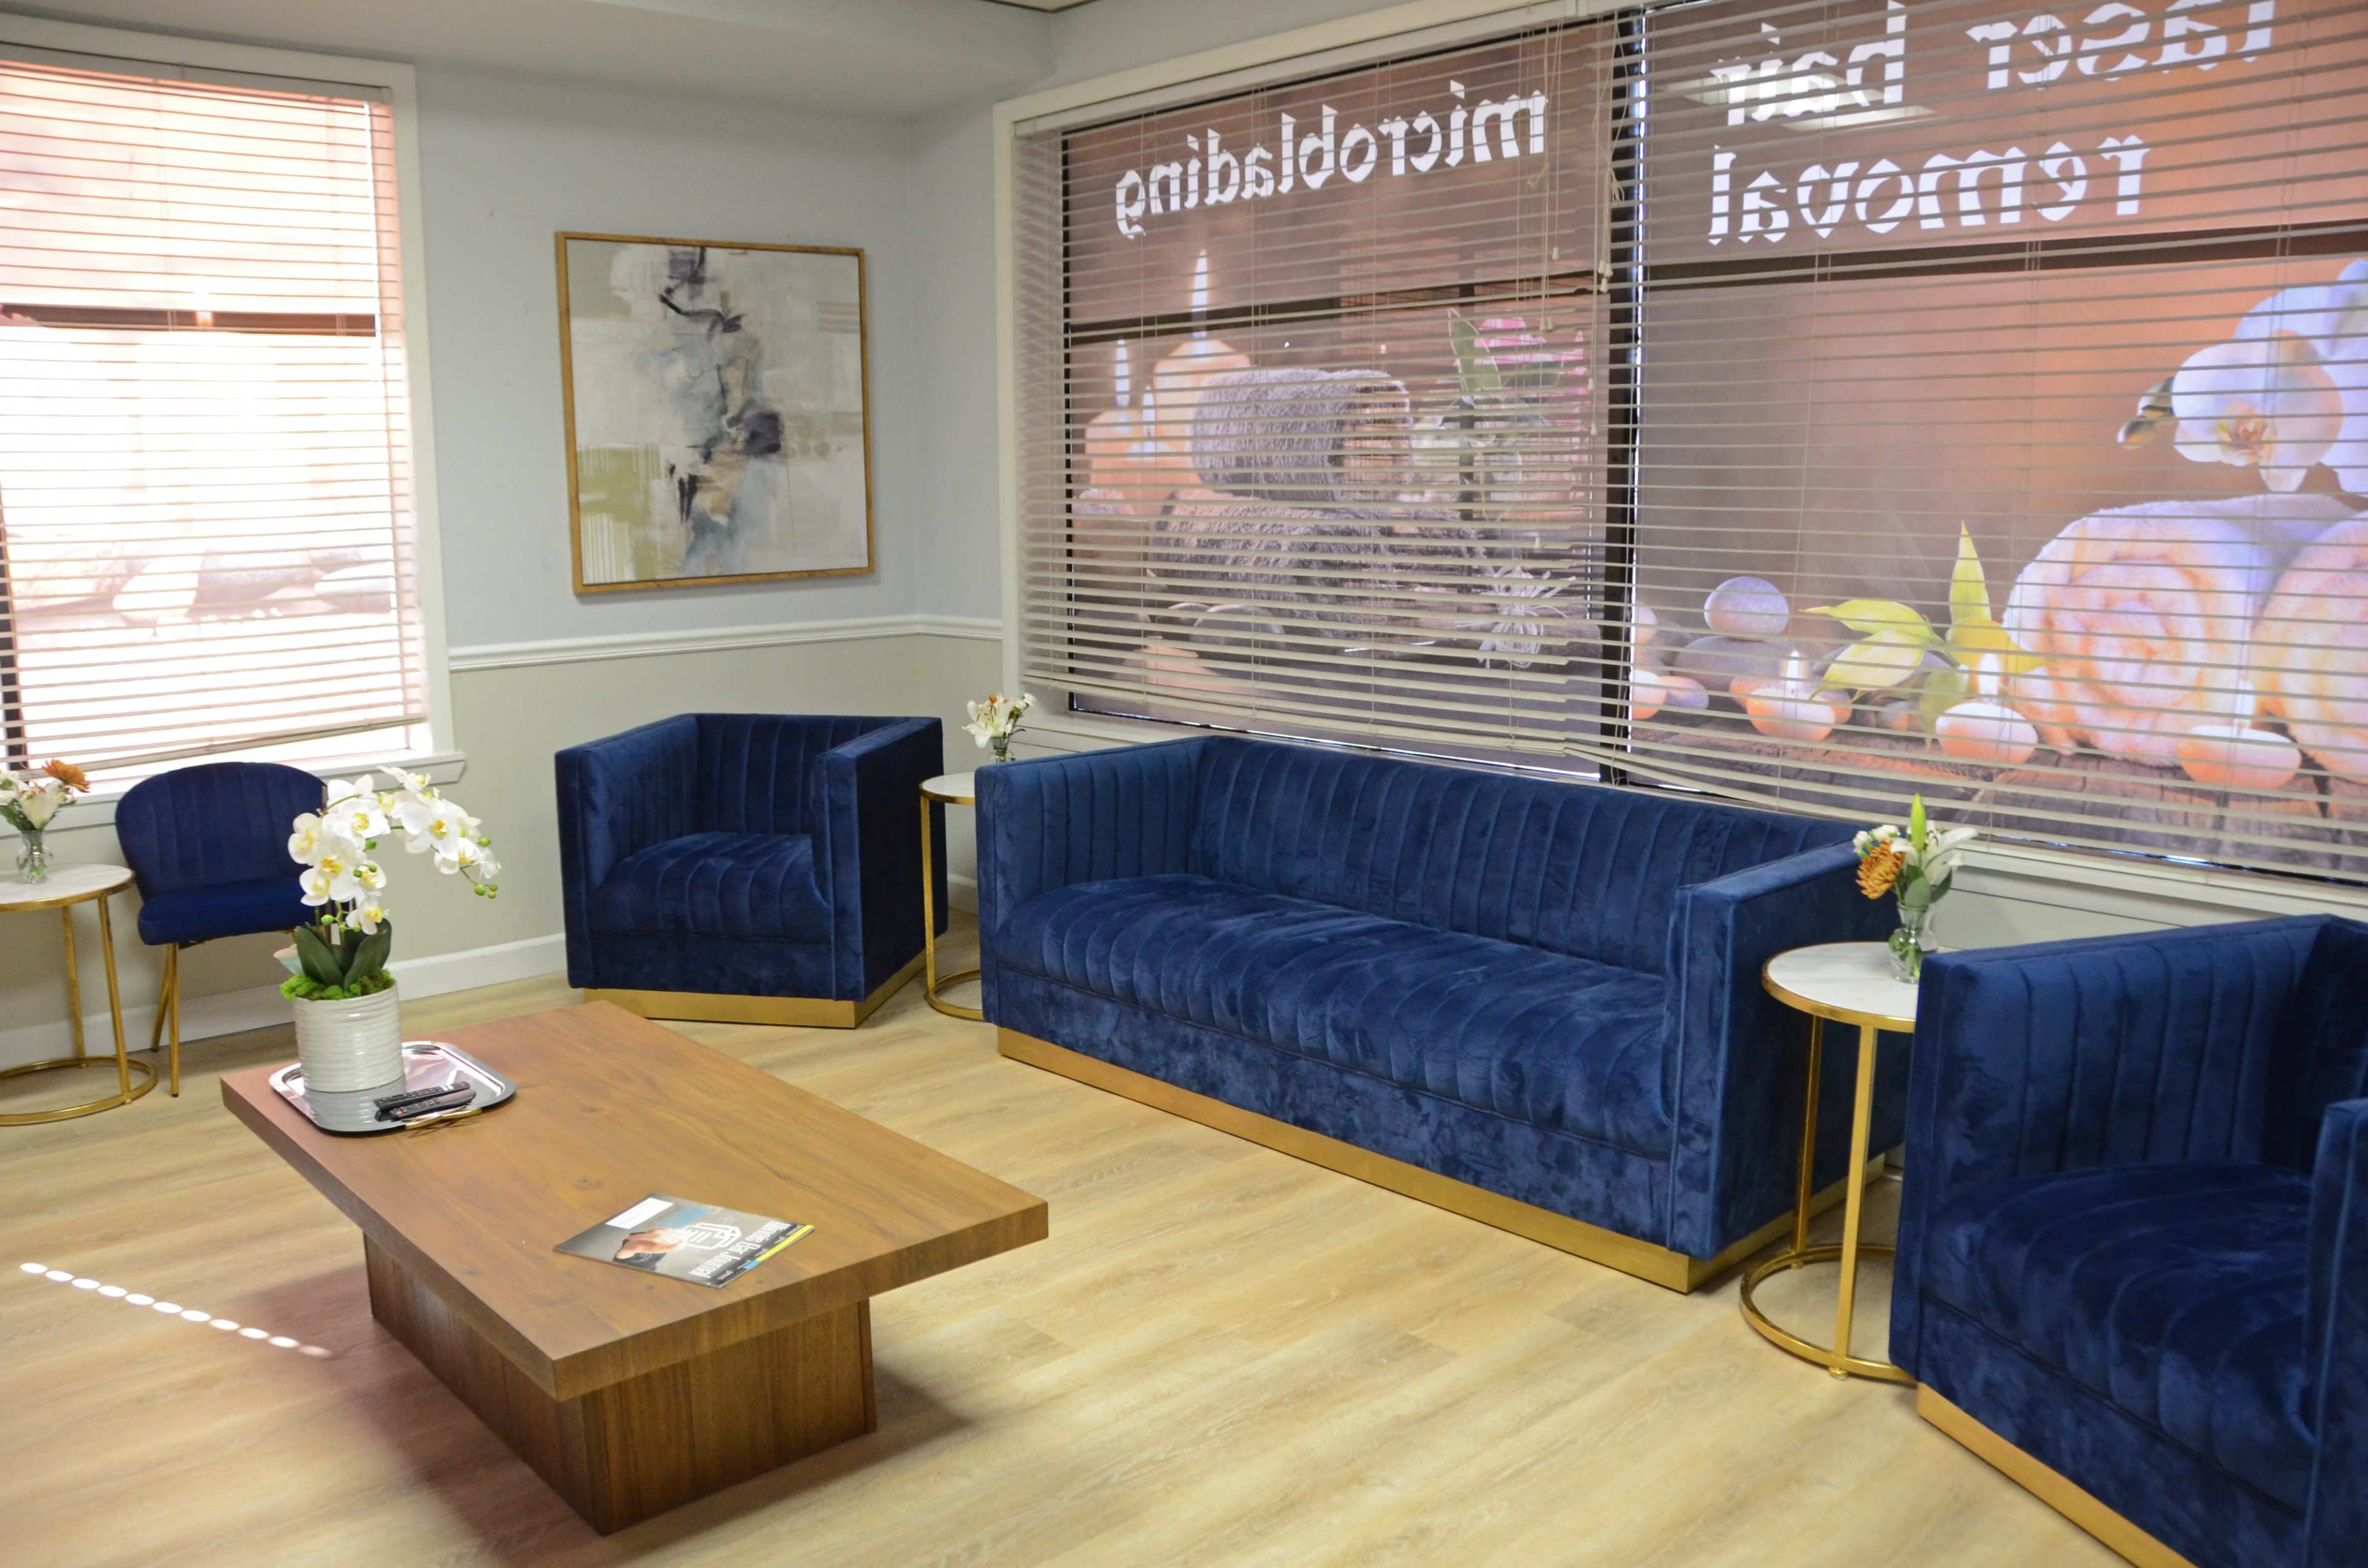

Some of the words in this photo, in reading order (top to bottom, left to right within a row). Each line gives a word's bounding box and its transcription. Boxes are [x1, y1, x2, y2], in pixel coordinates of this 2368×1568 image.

[744, 1221, 792, 1243] Illinois
[728, 1241, 760, 1254] Bar
[688, 1251, 741, 1278] Journal
